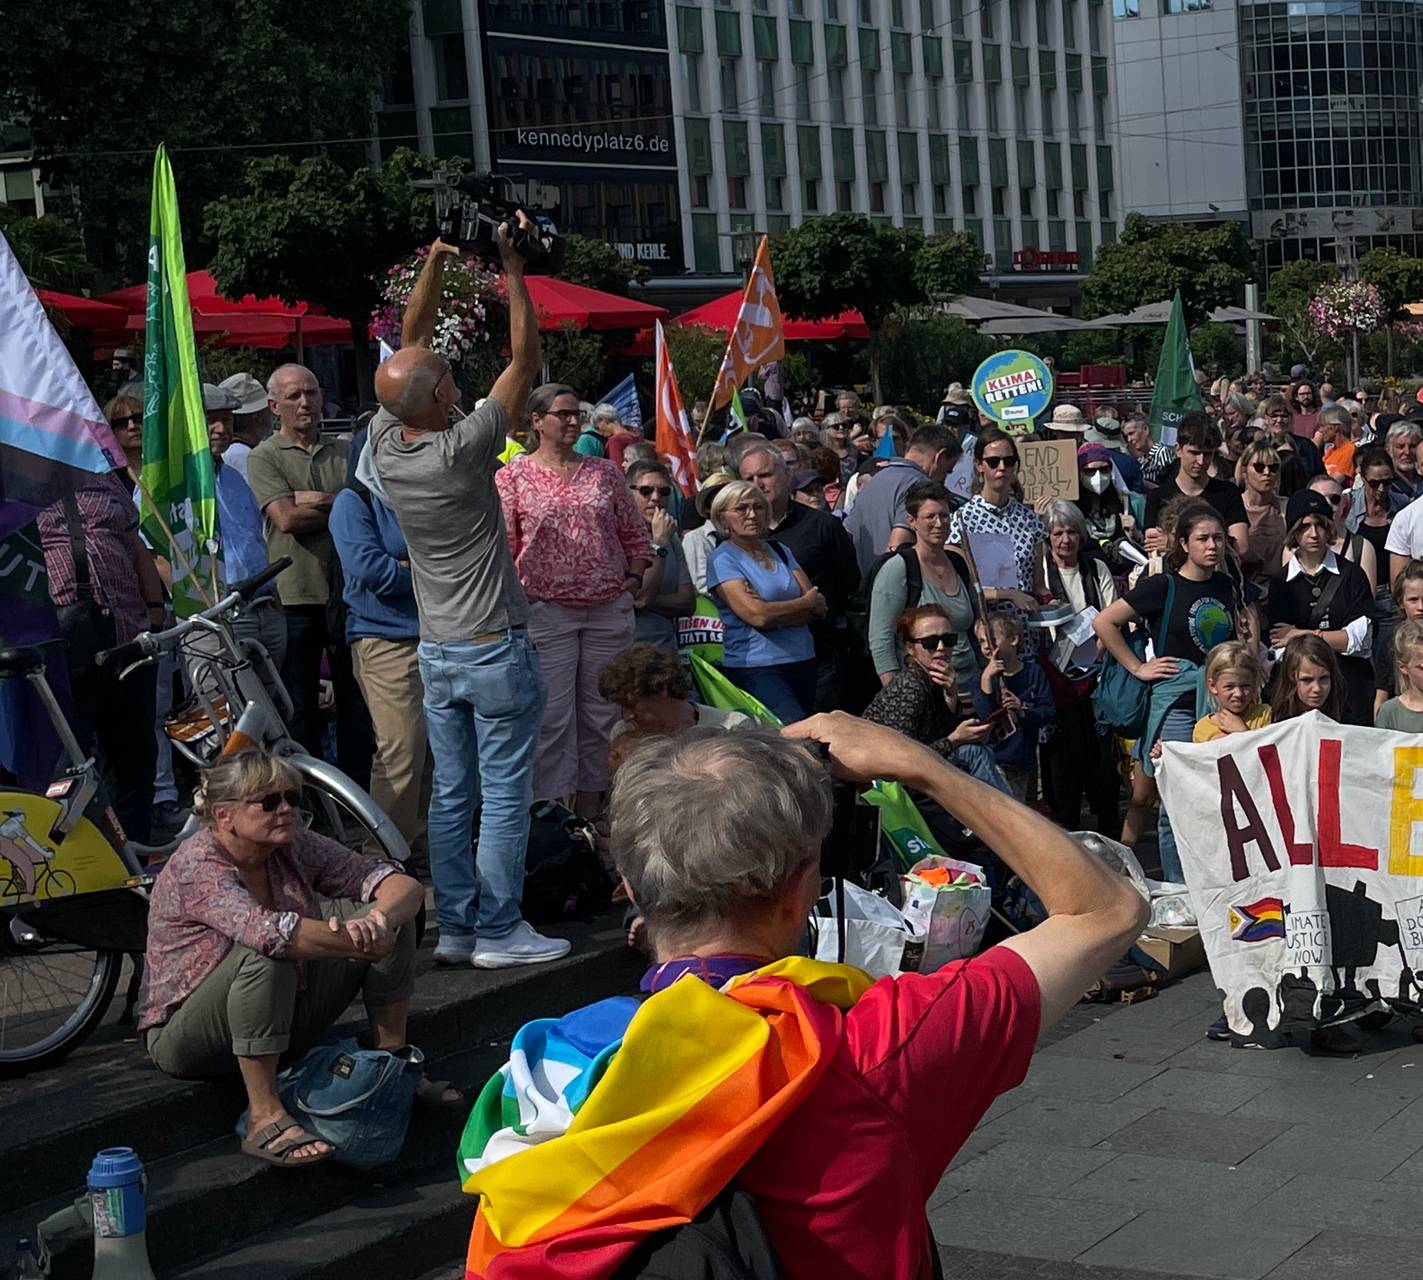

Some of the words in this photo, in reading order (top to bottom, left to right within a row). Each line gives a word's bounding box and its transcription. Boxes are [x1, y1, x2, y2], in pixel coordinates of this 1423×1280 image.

[517, 127, 669, 152] kennedyplatz6.de
[988, 371, 1034, 391] KLIMA
[985, 379, 1043, 404] RETTEN!
[1025, 446, 1059, 466] END
[1286, 931, 1329, 949] USTICE
[1294, 949, 1323, 965] NOW
